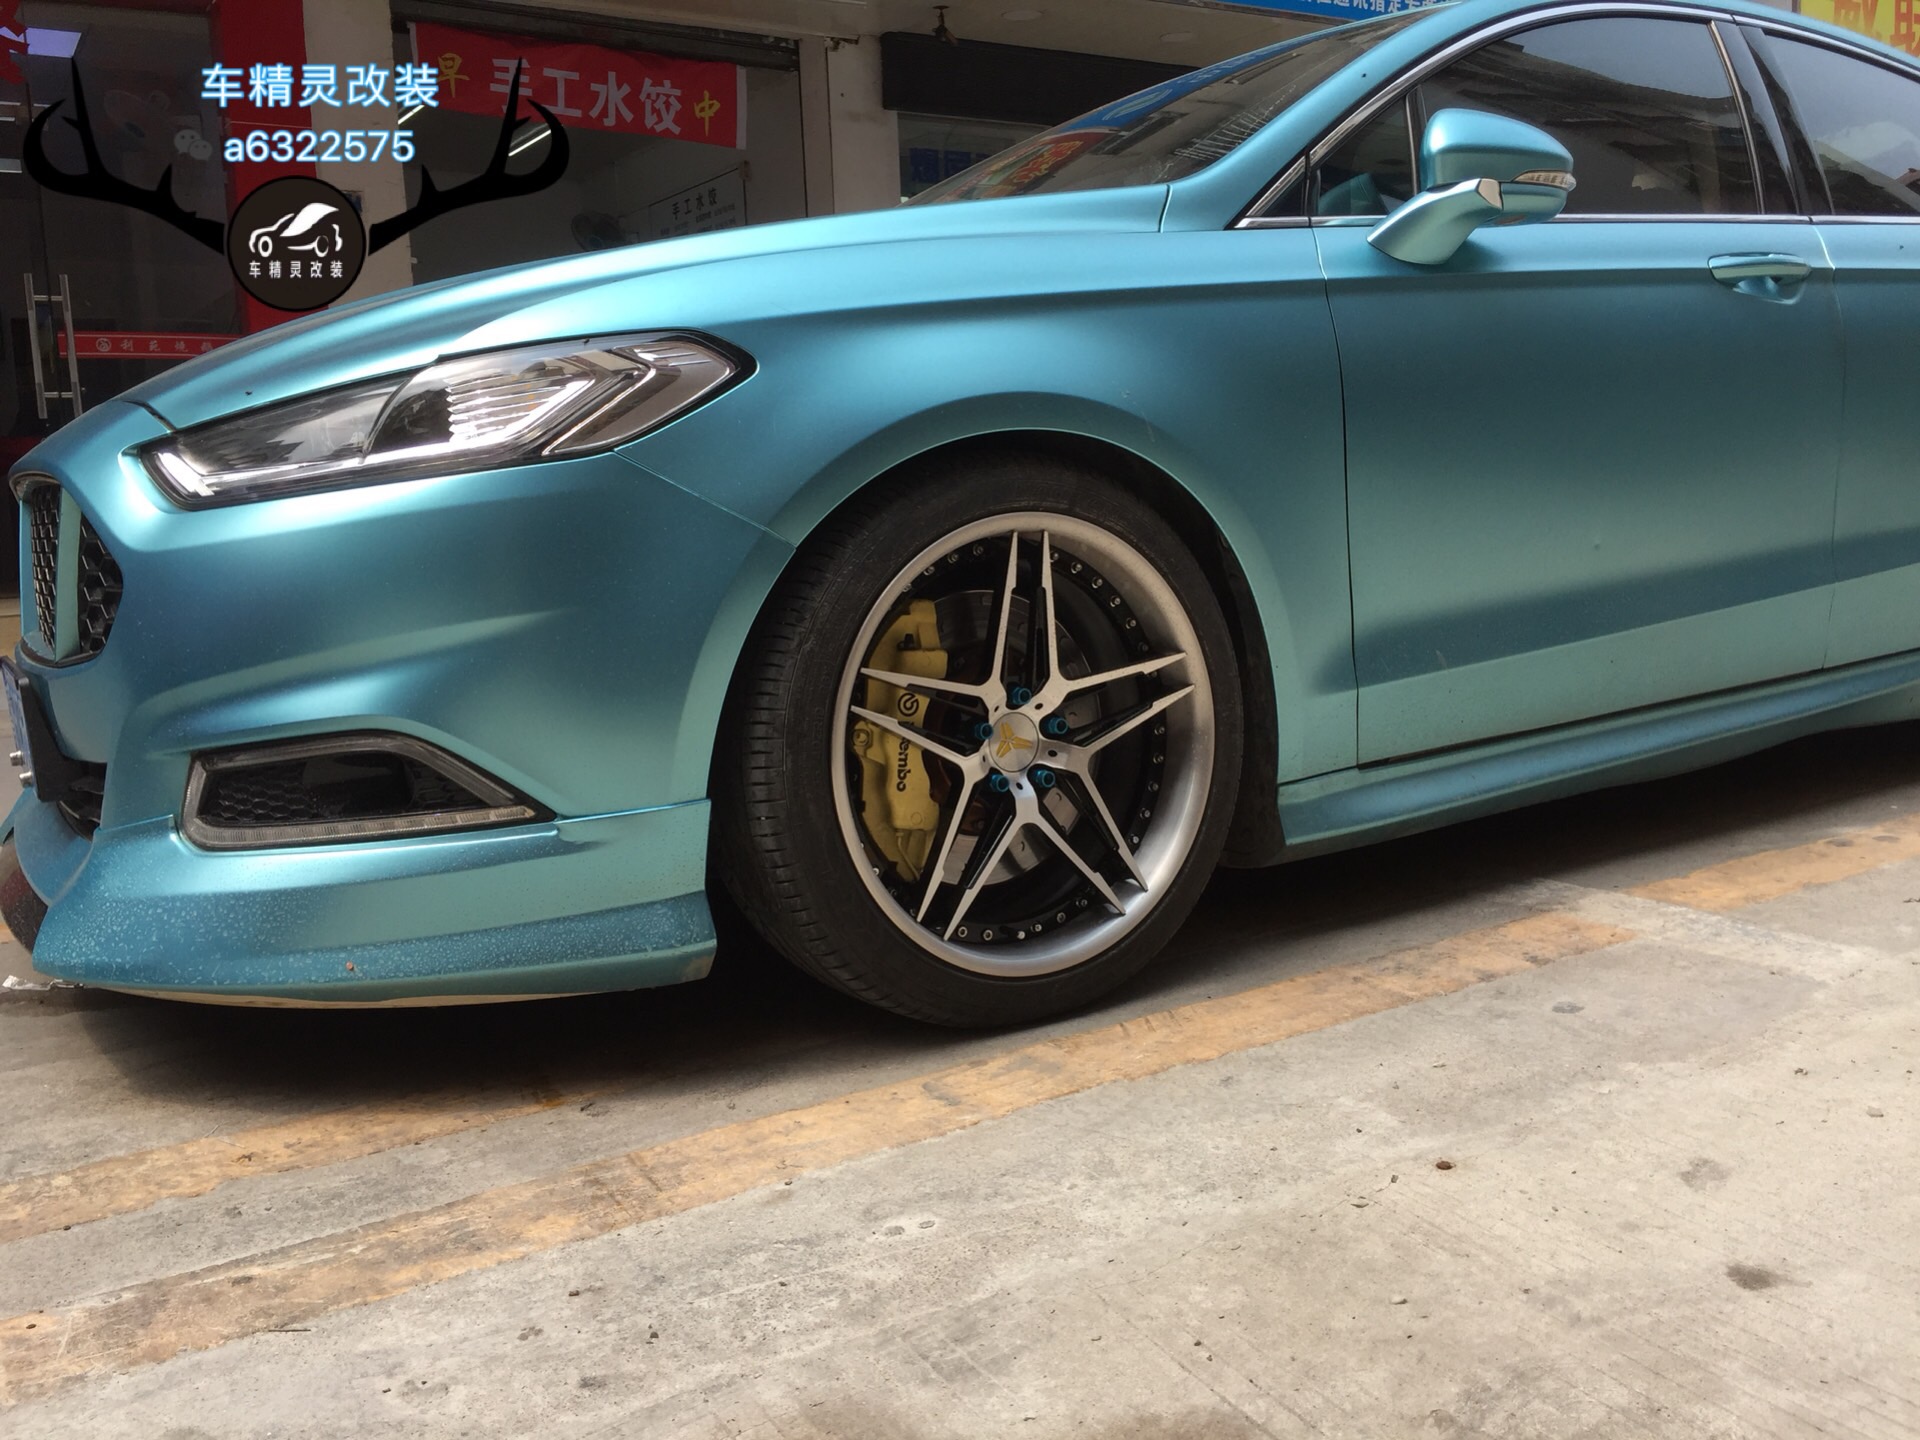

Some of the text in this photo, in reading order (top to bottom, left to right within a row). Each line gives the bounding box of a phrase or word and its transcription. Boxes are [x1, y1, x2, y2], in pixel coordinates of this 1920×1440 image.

[437, 52, 721, 137] 早 手工水饺 中
[896, 721, 914, 792] embo
